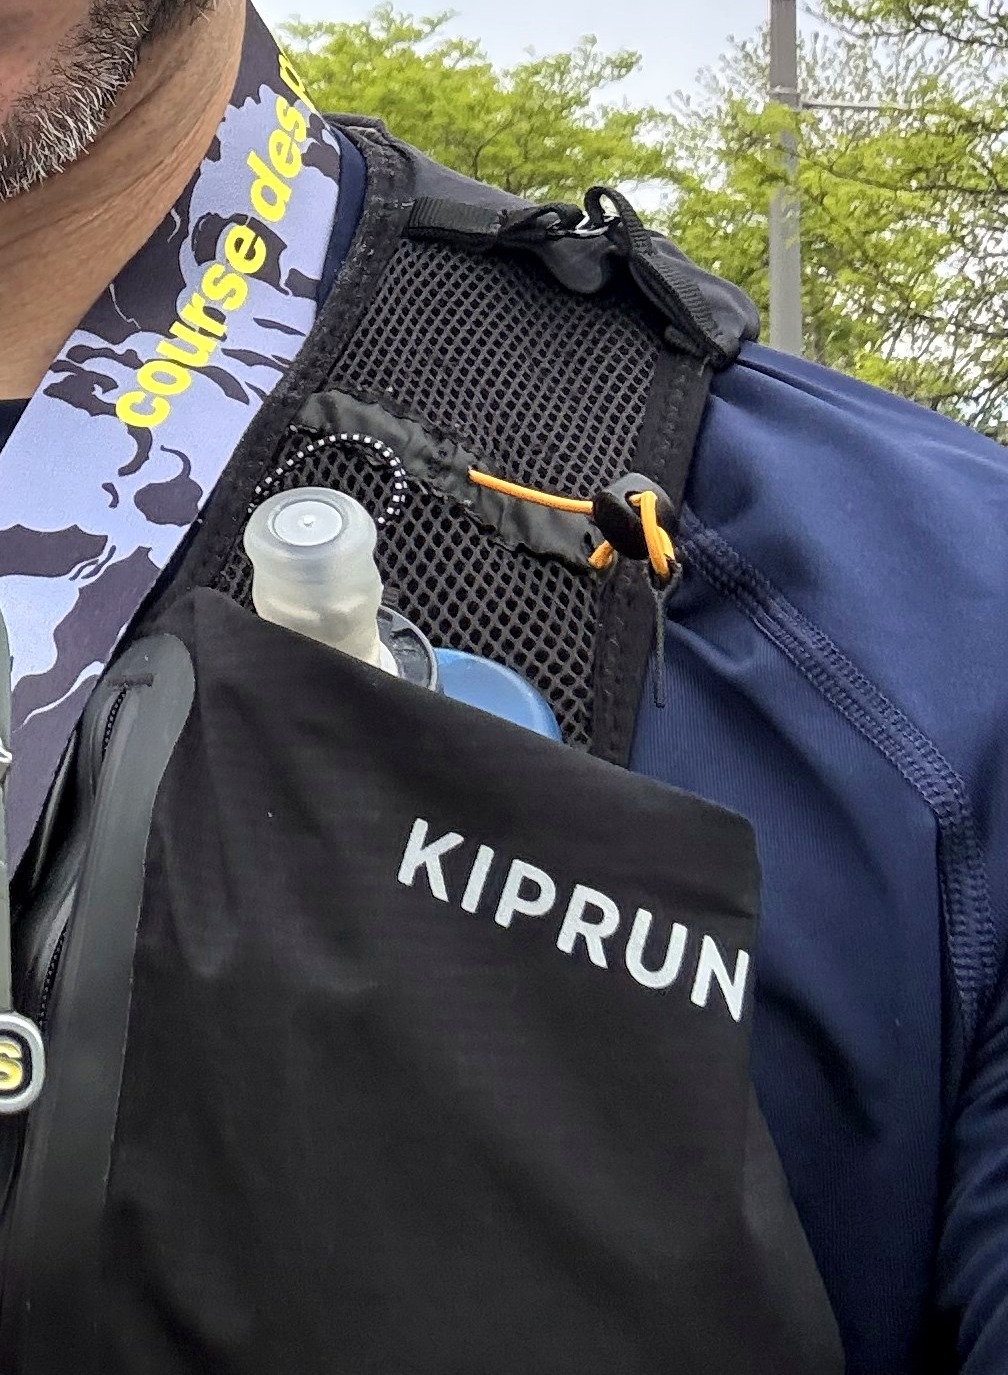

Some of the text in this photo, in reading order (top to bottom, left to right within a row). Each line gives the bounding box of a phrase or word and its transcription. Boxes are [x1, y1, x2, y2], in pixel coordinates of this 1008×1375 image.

[115, 96, 308, 428] course des
[397, 818, 750, 1023] KIPRUN
